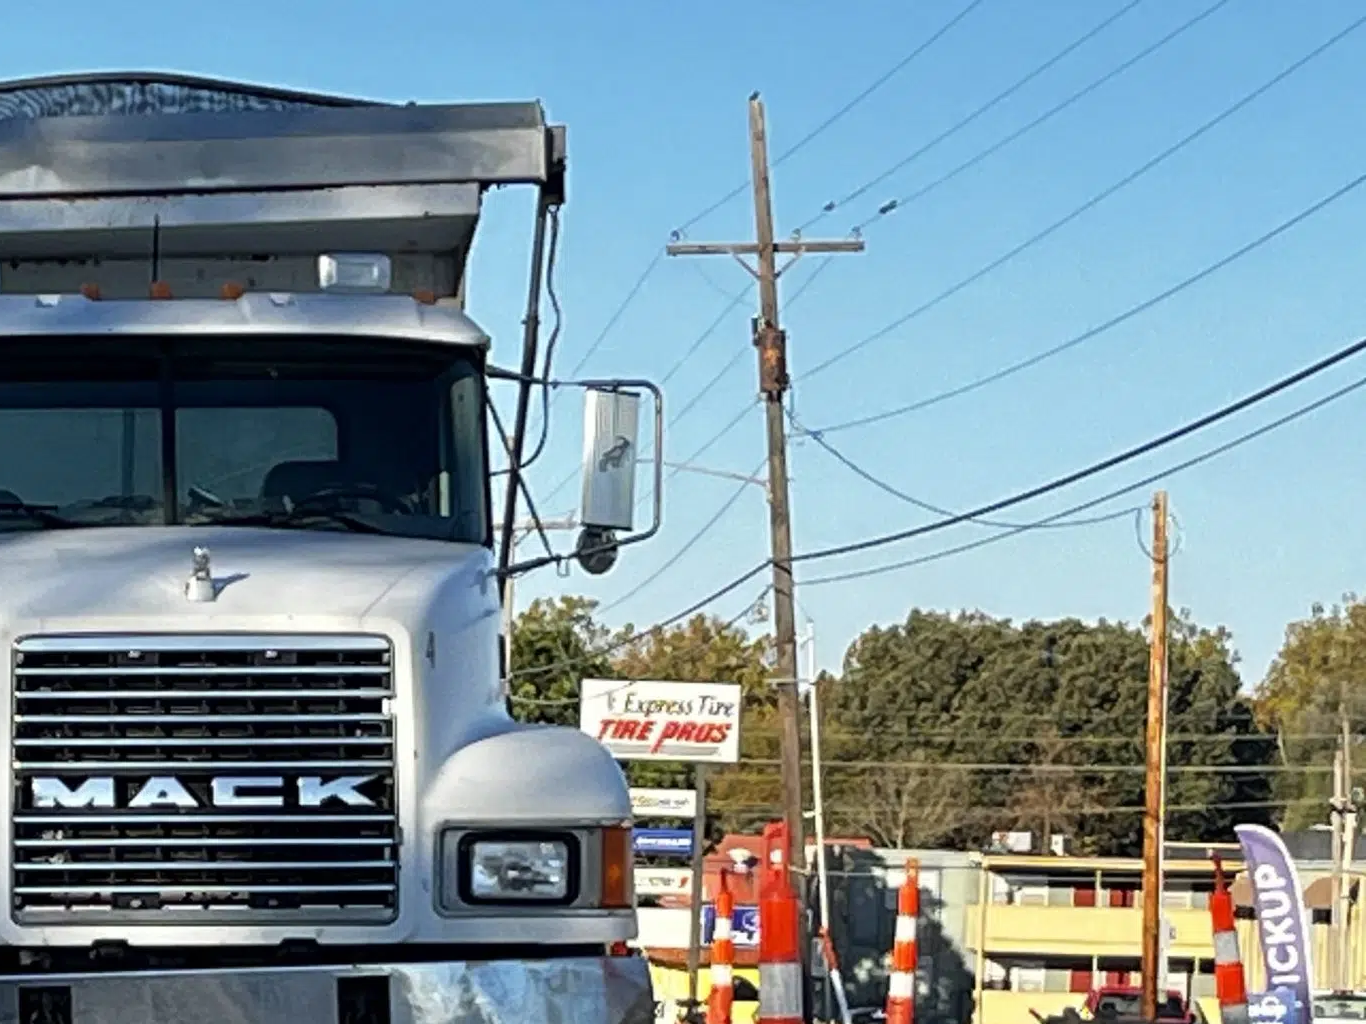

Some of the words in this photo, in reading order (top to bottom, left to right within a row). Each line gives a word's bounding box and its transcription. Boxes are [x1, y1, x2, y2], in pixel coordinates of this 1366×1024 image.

[624, 692, 694, 717] Express
[597, 719, 656, 741] TIRE
[649, 720, 733, 754] PROS
[31, 776, 380, 807] MACK
[1254, 863, 1302, 1006] ICKUP
